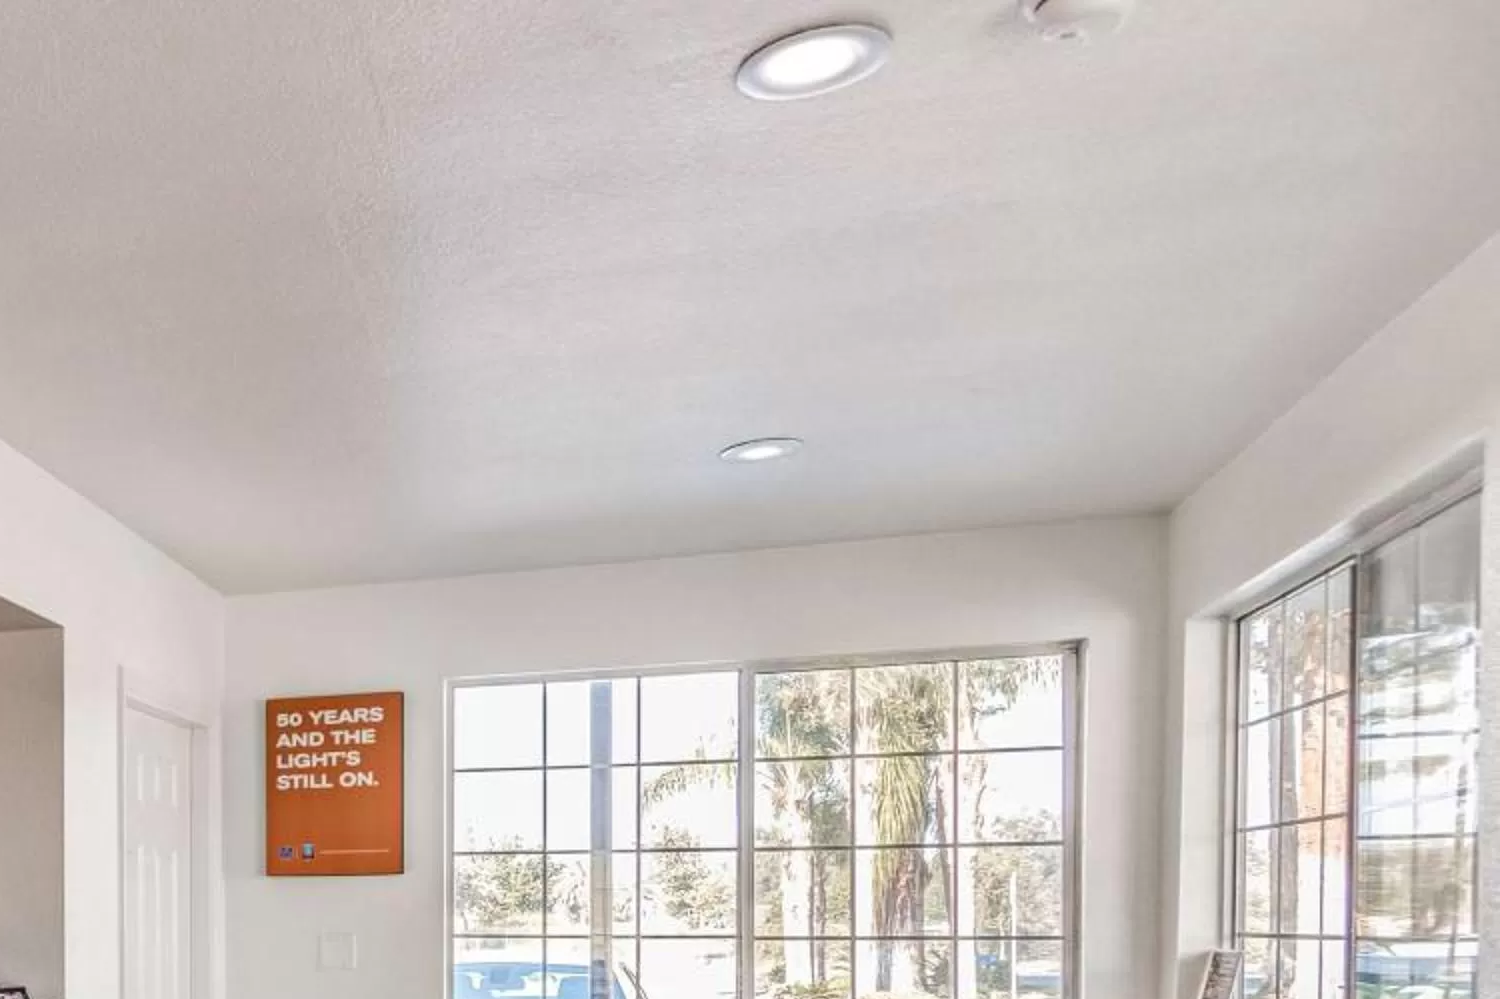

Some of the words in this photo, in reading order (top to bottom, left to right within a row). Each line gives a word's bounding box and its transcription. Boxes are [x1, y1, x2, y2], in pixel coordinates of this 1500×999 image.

[276, 713, 302, 728] 50
[309, 707, 385, 725] YEARS
[276, 731, 325, 748] AND
[329, 728, 377, 745] THE
[276, 750, 361, 769] LIGHT'S
[276, 773, 334, 790] STILL
[339, 771, 380, 788] ON.
